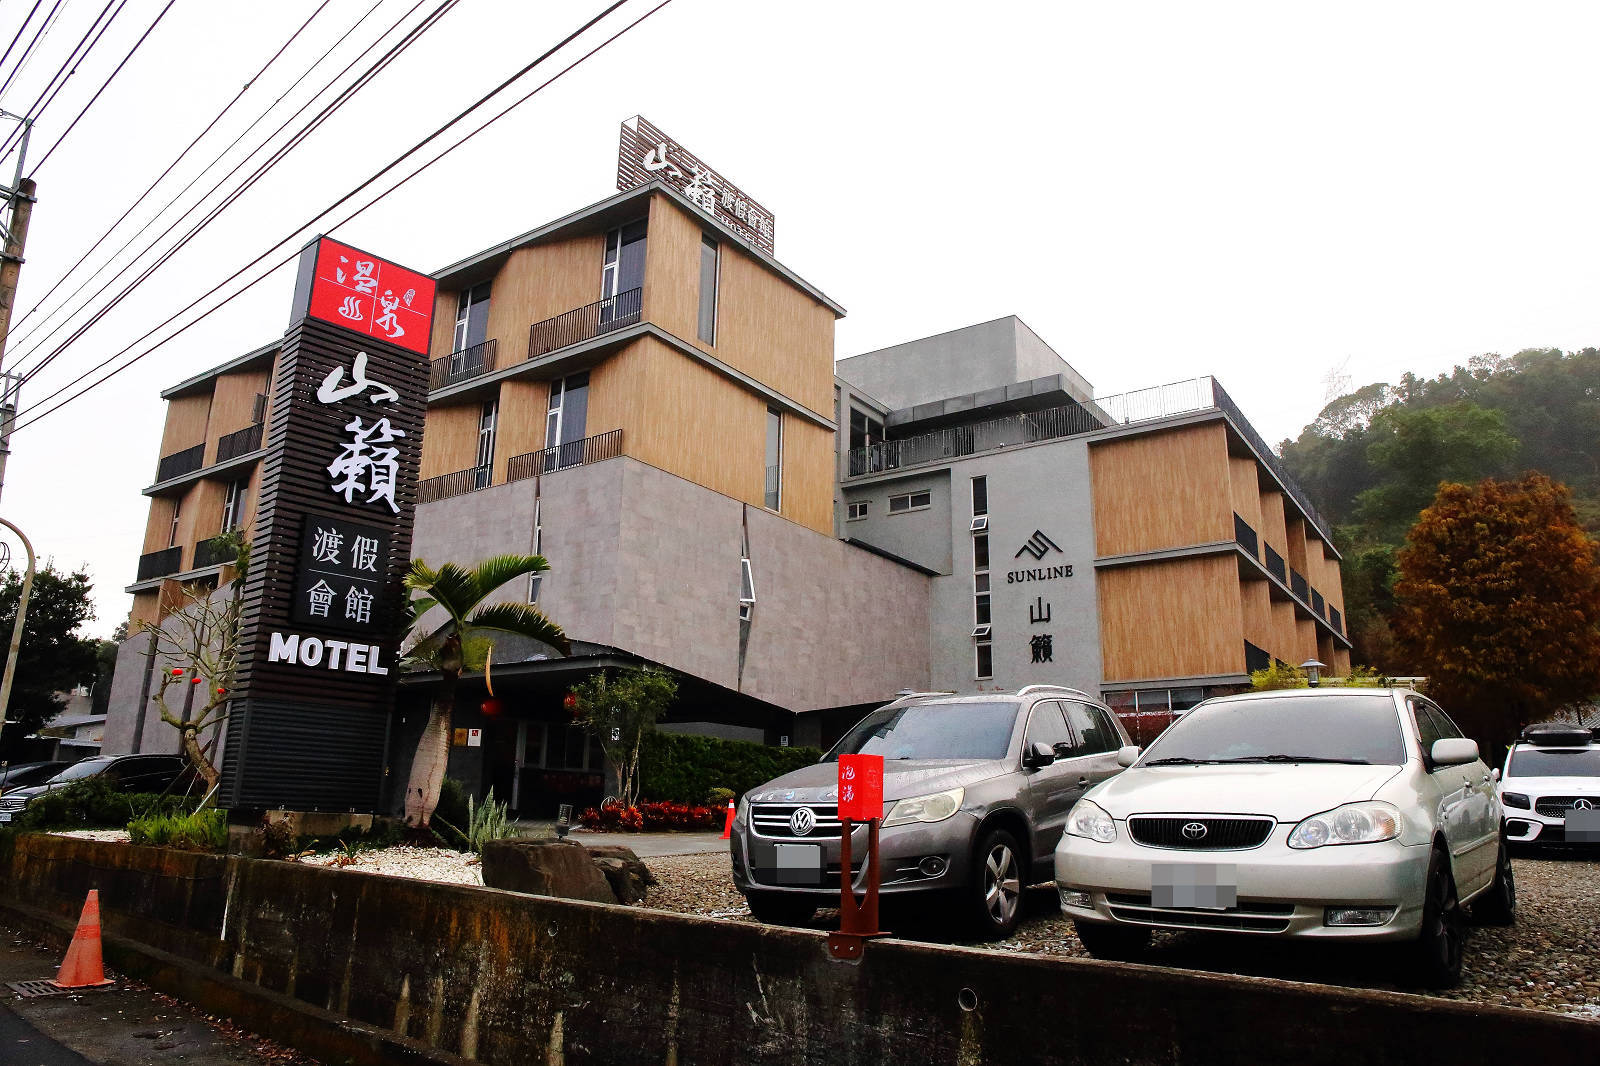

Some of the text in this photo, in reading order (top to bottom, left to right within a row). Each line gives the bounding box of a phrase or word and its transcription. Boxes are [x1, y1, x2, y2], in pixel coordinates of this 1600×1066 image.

[312, 526, 379, 573] 渡假
[1007, 564, 1074, 584] SUNLINE
[306, 578, 375, 624] 會館
[267, 632, 389, 676] MOTEL
